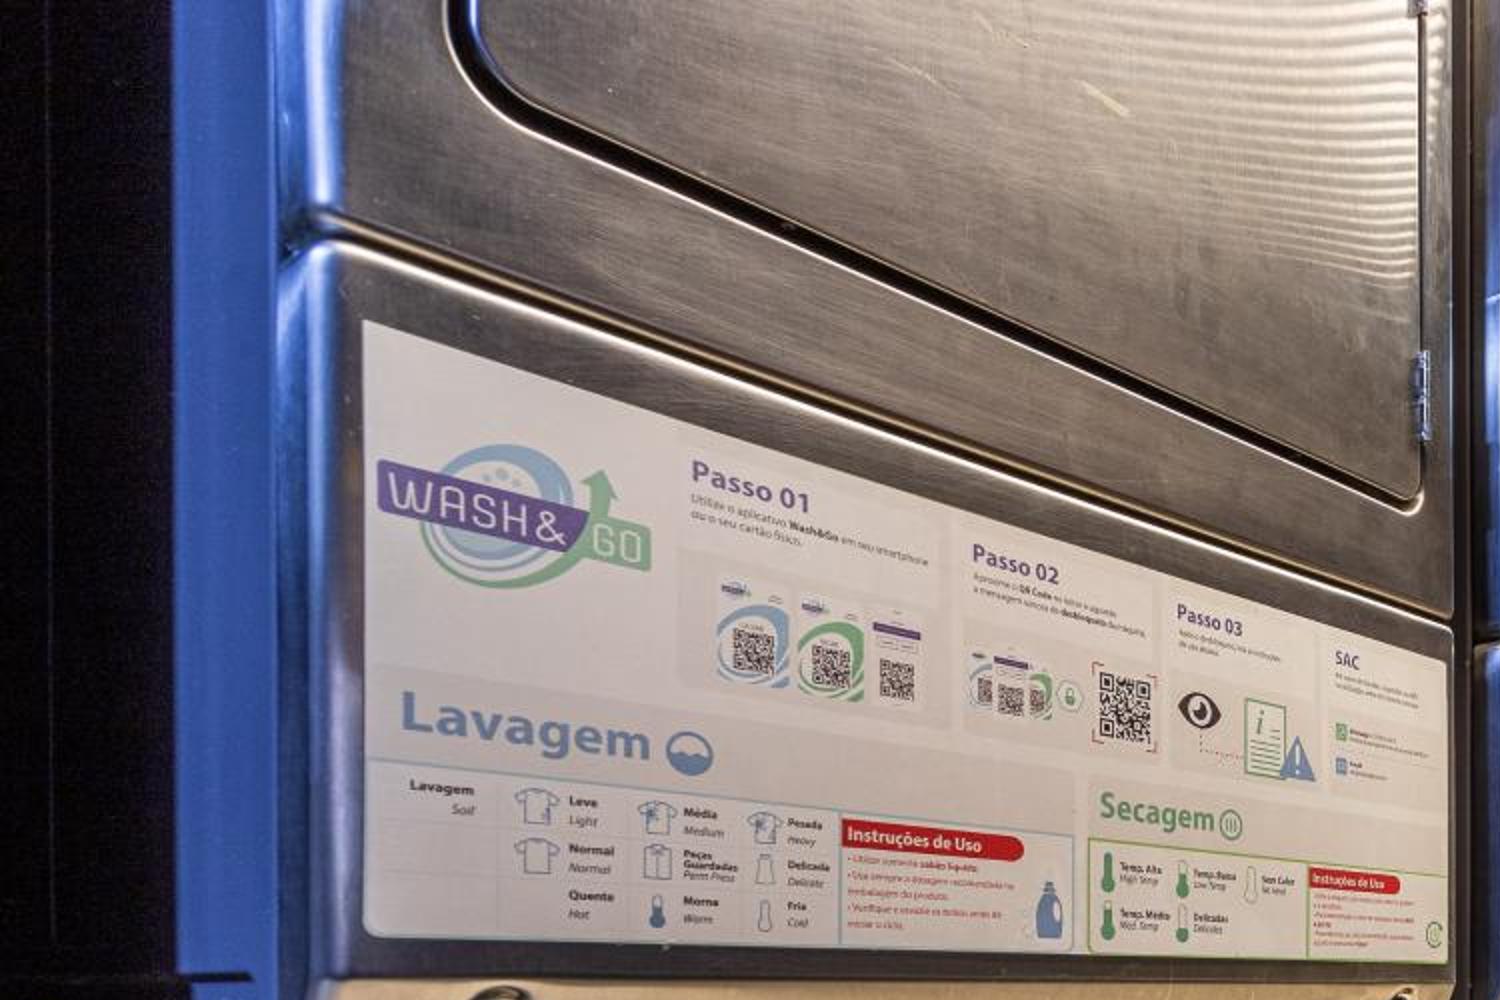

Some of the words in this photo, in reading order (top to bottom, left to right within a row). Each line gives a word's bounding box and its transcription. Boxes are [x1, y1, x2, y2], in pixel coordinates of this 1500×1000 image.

[692, 460, 773, 502] Passo
[779, 487, 809, 513] 01
[386, 470, 568, 546] WASH&
[737, 507, 787, 527] aplicativo
[718, 518, 737, 530] seu
[739, 522, 773, 539] cartão
[593, 522, 643, 563] GO
[973, 543, 1031, 577] Passo
[1036, 563, 1060, 585] 02
[1177, 603, 1221, 631] Passo
[1225, 618, 1243, 637] 03
[1335, 650, 1360, 671] SAC
[401, 690, 650, 760] Lavagem
[409, 779, 475, 797] Lavagem
[569, 796, 598, 809] Leve
[1100, 791, 1215, 834] Secagem
[569, 814, 598, 828] Light
[848, 826, 930, 849] Instruções
[933, 835, 951, 849] de
[954, 838, 983, 853] Uso
[568, 843, 615, 857] Normal
[568, 863, 611, 876] Normal
[568, 889, 615, 903] Quente
[683, 896, 720, 908] Morna
[568, 908, 590, 921] Hot
[787, 901, 807, 912] Fria
